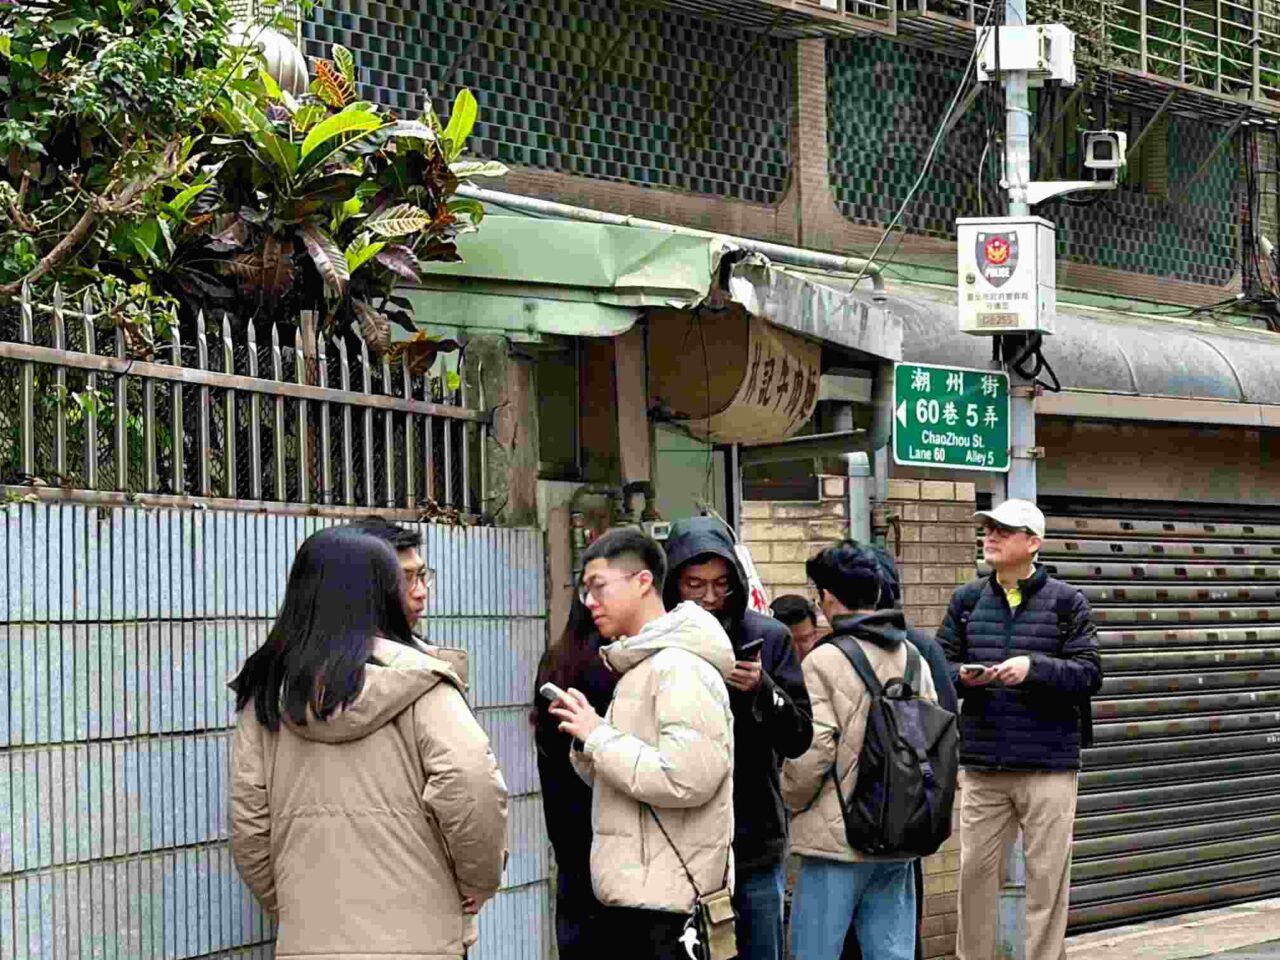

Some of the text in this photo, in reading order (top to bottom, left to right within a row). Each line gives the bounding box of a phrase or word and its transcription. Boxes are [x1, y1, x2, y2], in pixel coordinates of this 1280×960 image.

[911, 367, 1000, 399] 潮州街
[921, 430, 985, 448] ChaoZhou St.
[909, 445, 994, 466] Lane 60 Alley 5
